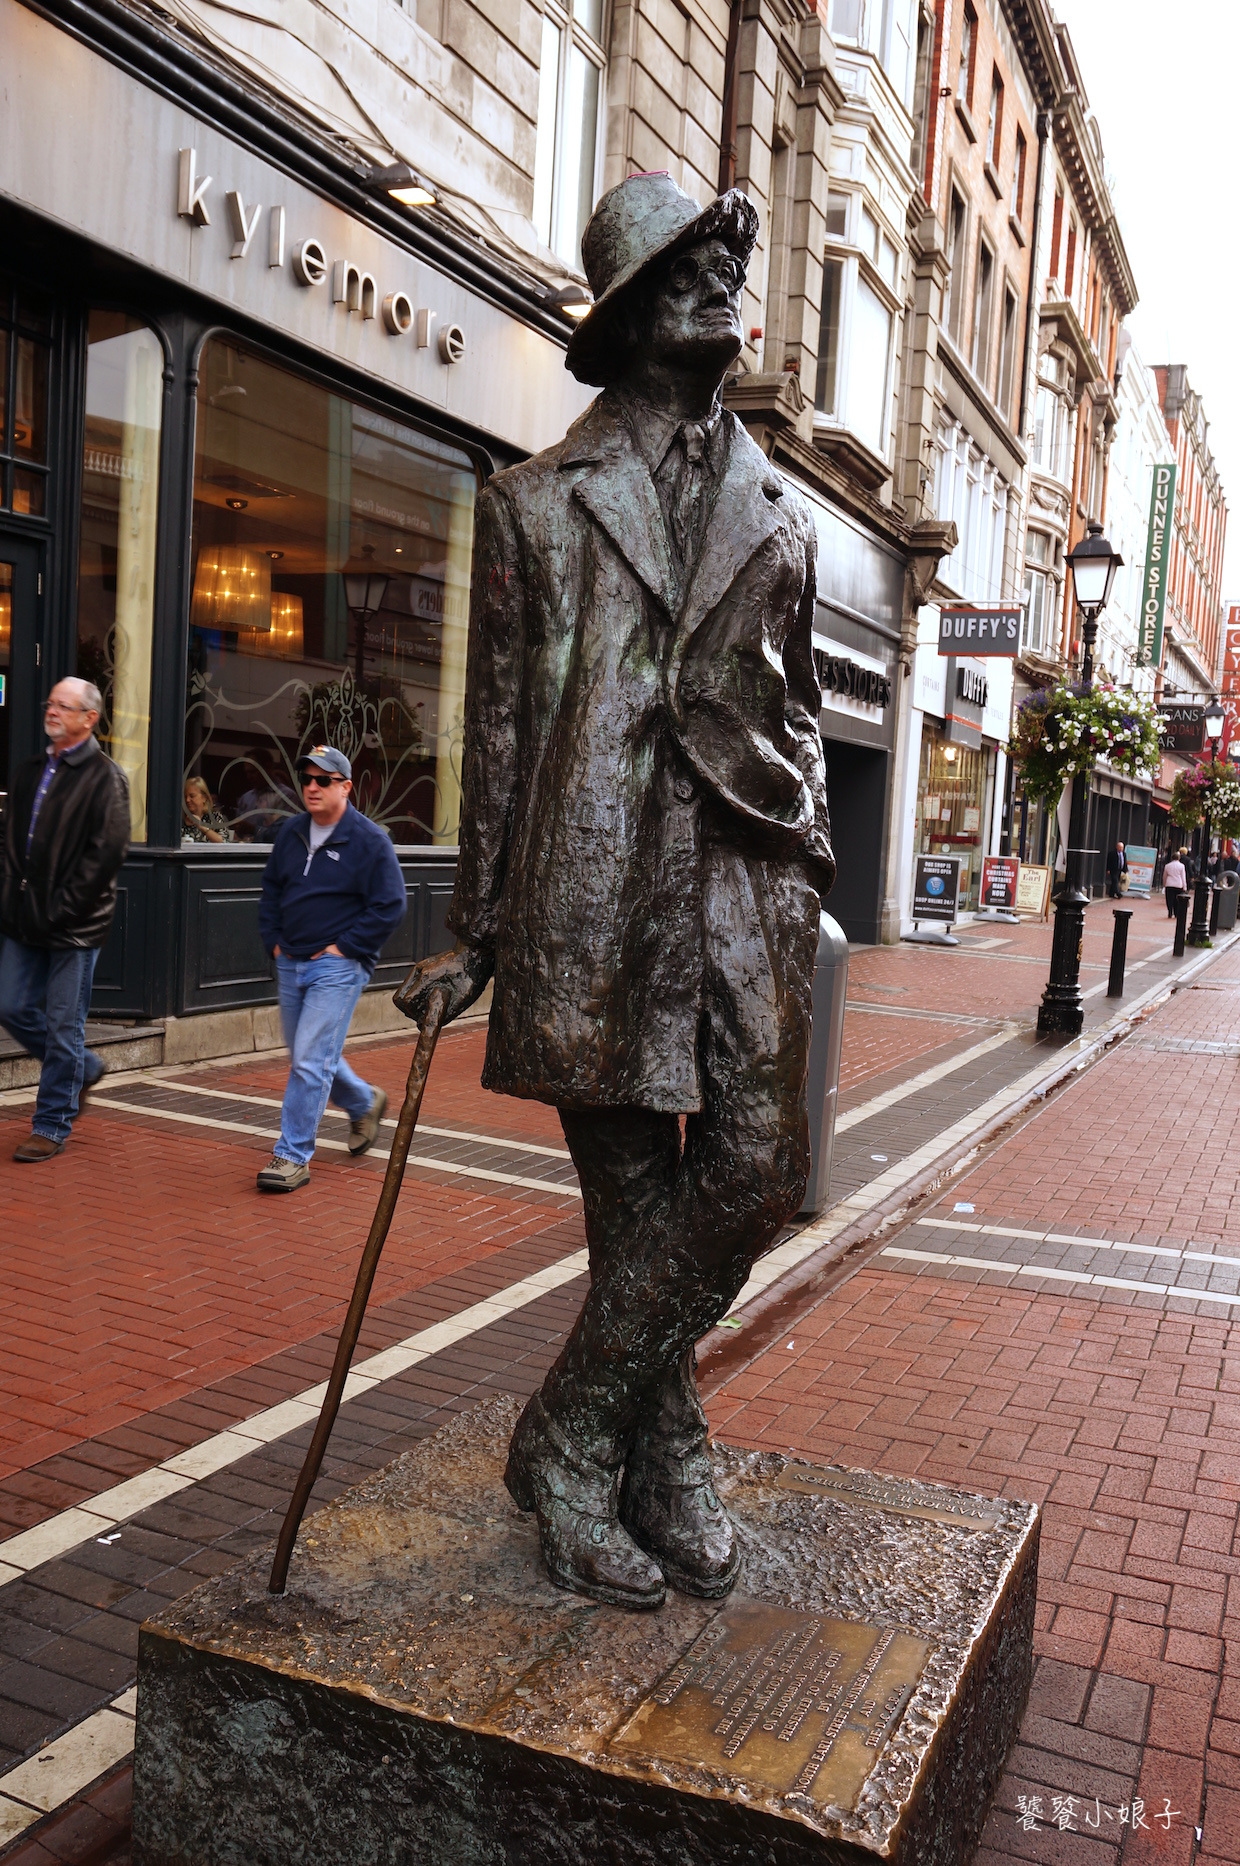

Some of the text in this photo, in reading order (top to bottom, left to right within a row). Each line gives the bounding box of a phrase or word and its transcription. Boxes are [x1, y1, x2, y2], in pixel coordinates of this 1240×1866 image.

[177, 148, 466, 364] kylemore
[1143, 468, 1171, 660] DUNNES STORES
[942, 616, 1017, 639] DUFFY'S
[839, 657, 892, 708] STORES
[986, 869, 1015, 877] CHRISTMAS
[1023, 874, 1041, 882] Earl
[896, 1494, 984, 1519] MARJORIE
[654, 1626, 726, 1704] JAMES JOYCE
[712, 1693, 727, 1706] BY
[722, 1680, 740, 1694] THE
[715, 1718, 733, 1735] THE
[727, 1696, 748, 1718] LORD
[741, 1669, 769, 1697] MAYOR
[762, 1655, 776, 1667] OF
[723, 1711, 760, 1758] ALDERMAN
[753, 1675, 784, 1710] SENATOR
[779, 1654, 799, 1674] SEAN
[762, 1717, 778, 1731] ON
[771, 1672, 808, 1718] BLOOMSDAY
[778, 1651, 842, 1742] PRESENTED TO THE CITY
[793, 1626, 896, 1793] NORTH EARL STREET BUSINESS ASSOCIATION
[818, 1683, 843, 1713] BY THE
[859, 1699, 876, 1718] AND
[865, 1729, 882, 1747] THE
